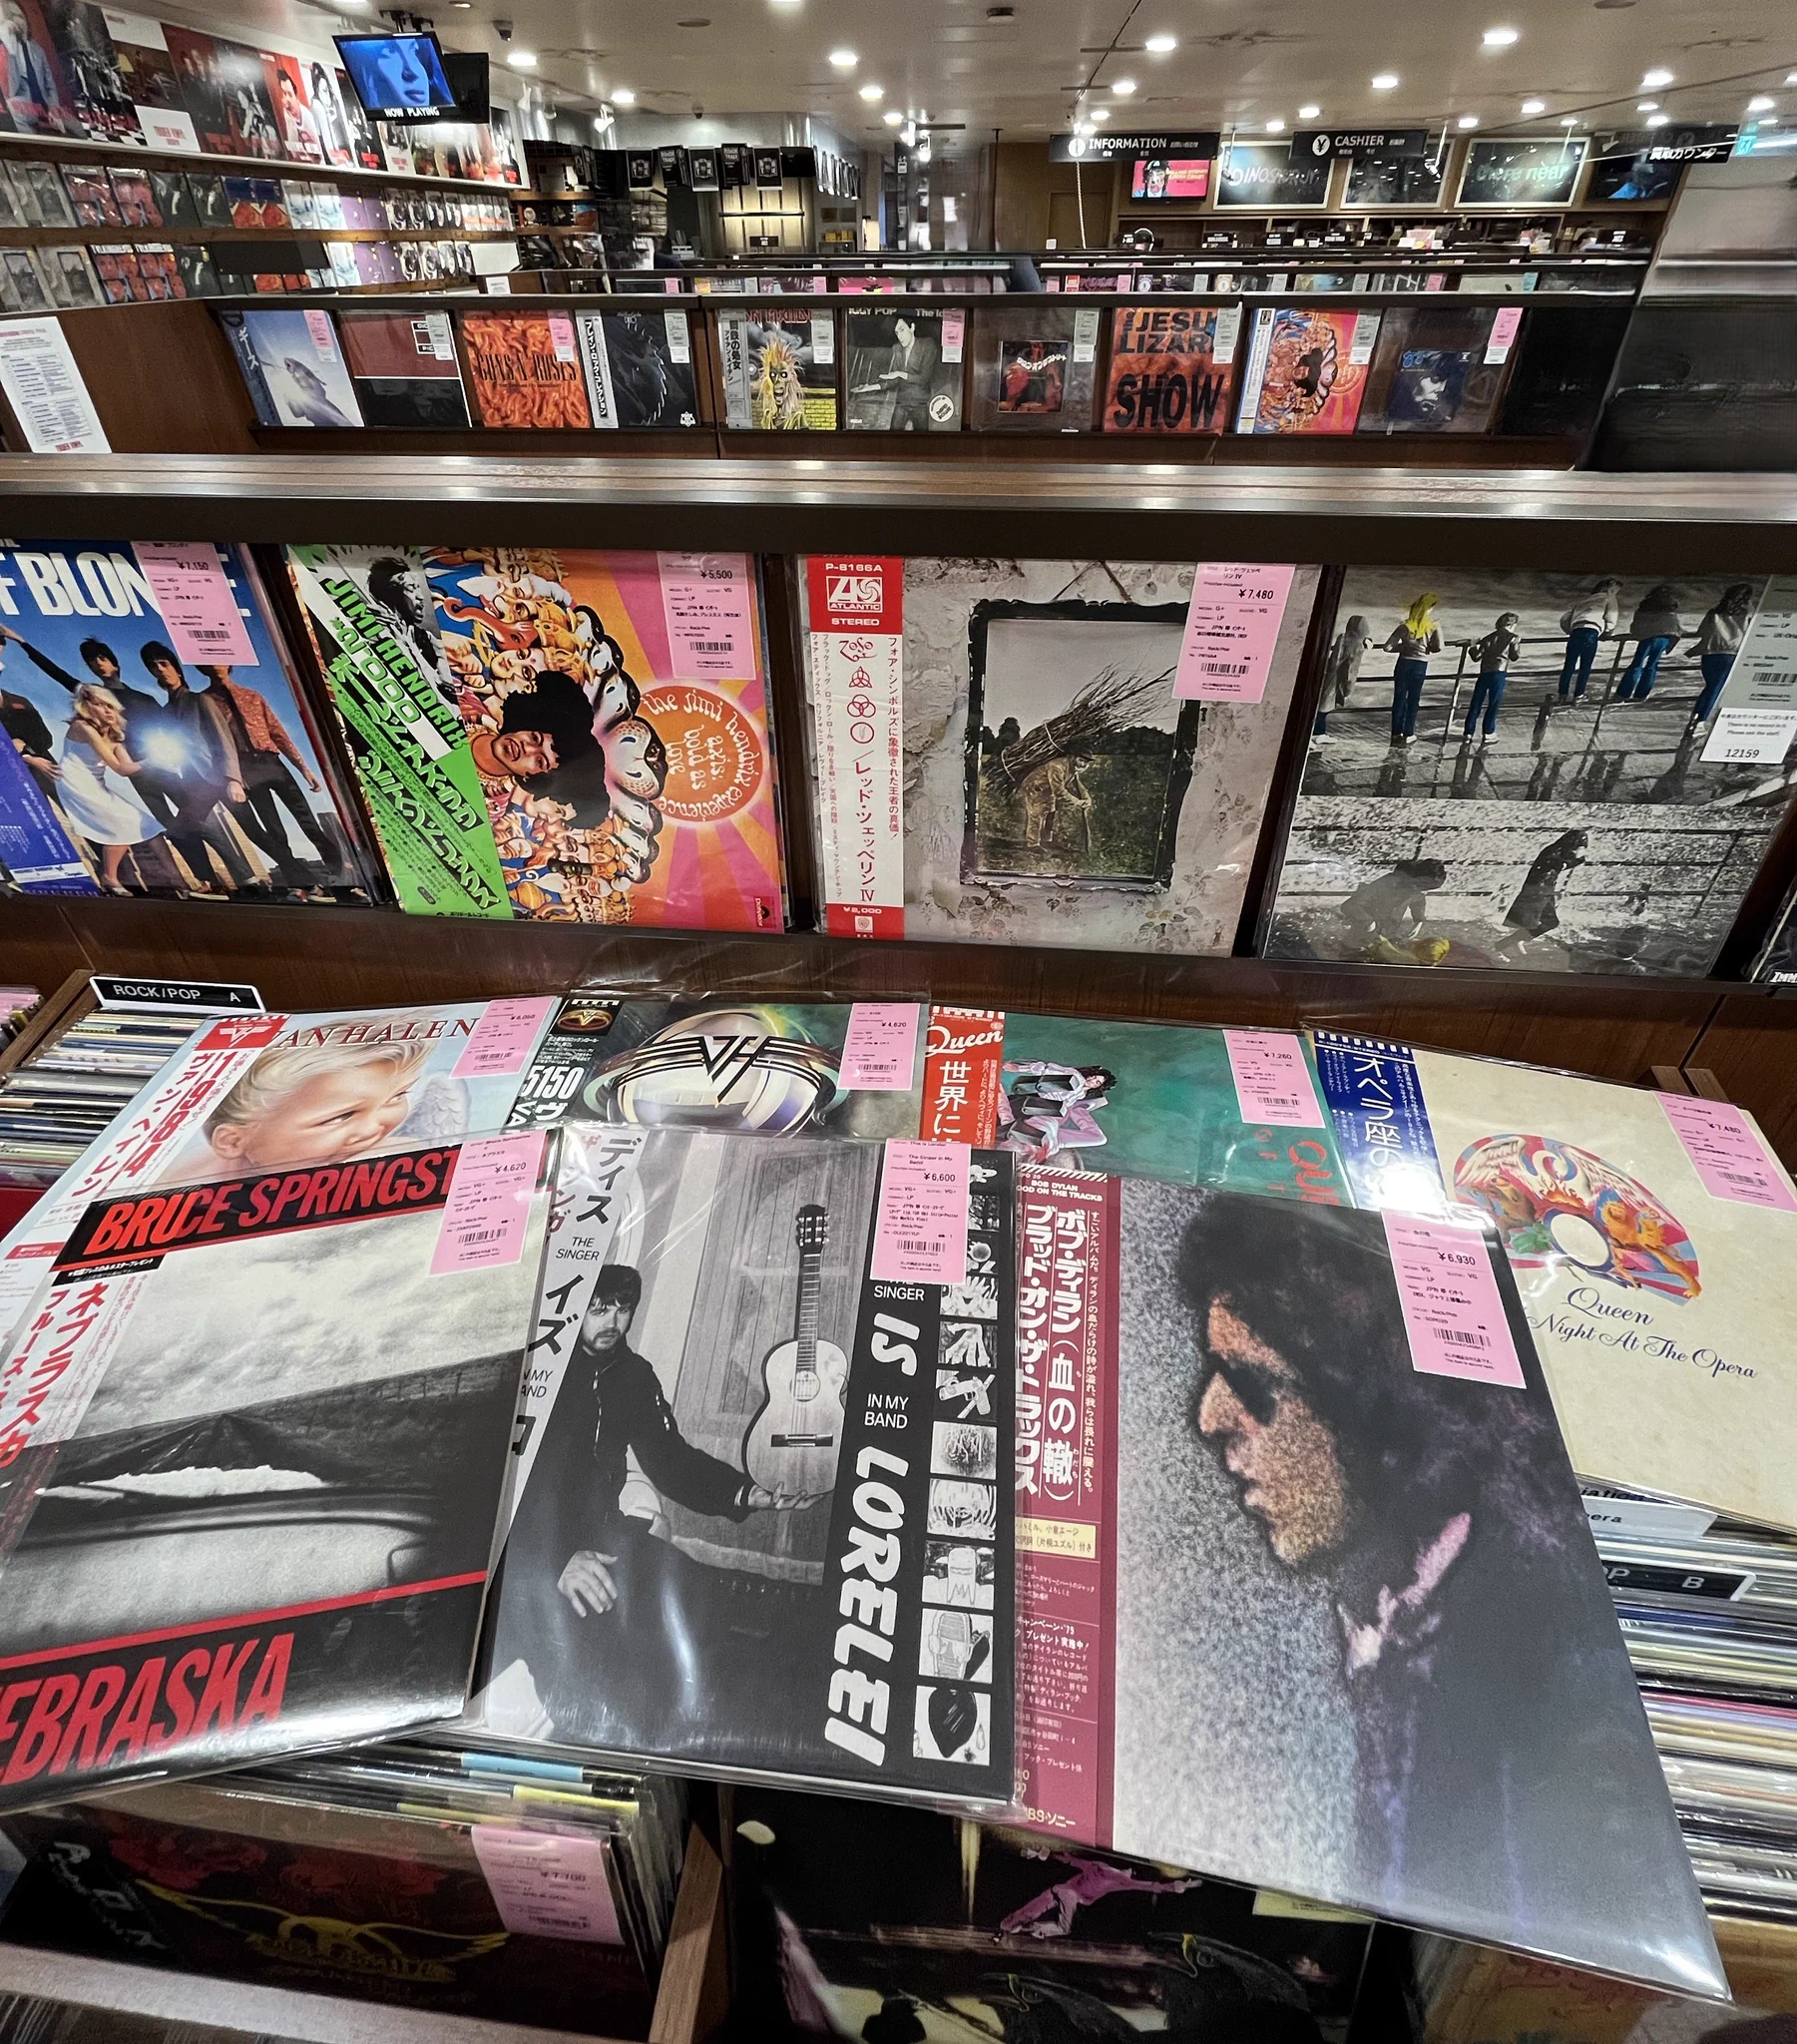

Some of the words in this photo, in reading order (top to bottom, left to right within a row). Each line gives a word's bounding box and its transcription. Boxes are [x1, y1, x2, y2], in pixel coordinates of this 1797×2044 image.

[407, 107, 439, 117] PLAYING
[1089, 138, 1166, 150] INFORMATION
[1334, 136, 1384, 147] CASHIER
[1650, 146, 1727, 161] 買取カウンター
[915, 308, 933, 317] The
[1135, 311, 1217, 332] JESU
[238, 326, 259, 370] ギース
[1120, 334, 1215, 353] LIZAR
[476, 353, 515, 381] GUNS
[532, 353, 578, 381] ROSES
[1114, 373, 1225, 428] SHOW
[700, 570, 732, 579] ¥5,500
[1238, 589, 1274, 600] ¥7,480
[319, 578, 384, 642] JIMI
[375, 638, 472, 751] HENDRIX
[645, 693, 678, 716] the
[684, 725, 709, 767] bold
[724, 712, 760, 787] hendrix
[1724, 749, 1760, 759] 12159
[666, 739, 685, 775] love
[690, 769, 707, 791] as
[659, 785, 743, 823] experience
[1769, 972, 1797, 983] IMM
[113, 983, 201, 1001] ROCK/POP
[228, 991, 241, 1003] A
[273, 1027, 339, 1051] AN
[335, 1017, 481, 1047] HALEN
[925, 1025, 1004, 1058] Queen
[520, 1066, 585, 1099] 5150
[535, 1102, 569, 1121] ヴ
[932, 1060, 972, 1143] 世界に
[124, 1051, 238, 1179] 1984
[507, 1100, 537, 1127] VA
[71, 1052, 217, 1198] ヴァン・ヘイレン
[1353, 1056, 1405, 1193] オペラ座の
[495, 1162, 527, 1174] ¥4,620
[924, 1172, 956, 1182] ¥6,600
[576, 1137, 643, 1225] ディス
[1051, 1182, 1079, 1192] DYLAN
[83, 1183, 242, 1256] BRUCE
[238, 1150, 460, 1228] SPRINGST
[1069, 1191, 1104, 1203] TRACKS
[572, 1237, 595, 1249] THE
[555, 1249, 600, 1262] SINGER
[1437, 1252, 1476, 1266] ¥6,930
[873, 1285, 925, 1301] SINGER
[528, 1275, 585, 1355] イズ
[1561, 1286, 1653, 1325] Queen
[870, 1311, 921, 1376] IS
[1527, 1312, 1596, 1342] Night
[1598, 1329, 1639, 1351] At
[1643, 1335, 1688, 1363] The
[1692, 1348, 1758, 1378] Opera
[0, 1281, 109, 1468] ネブラスカ
[532, 1369, 554, 1382] MY
[521, 1385, 548, 1398] AND
[867, 1393, 882, 1407] IN
[884, 1394, 909, 1409] MY
[864, 1412, 909, 1429] BAND
[1586, 1511, 1622, 1523] era
[1681, 1575, 1704, 1591] B
[824, 1445, 910, 1767] LORELEI
[0, 1632, 295, 1786] EBRASKA
[1024, 1807, 1077, 1827] BS・ソニー
